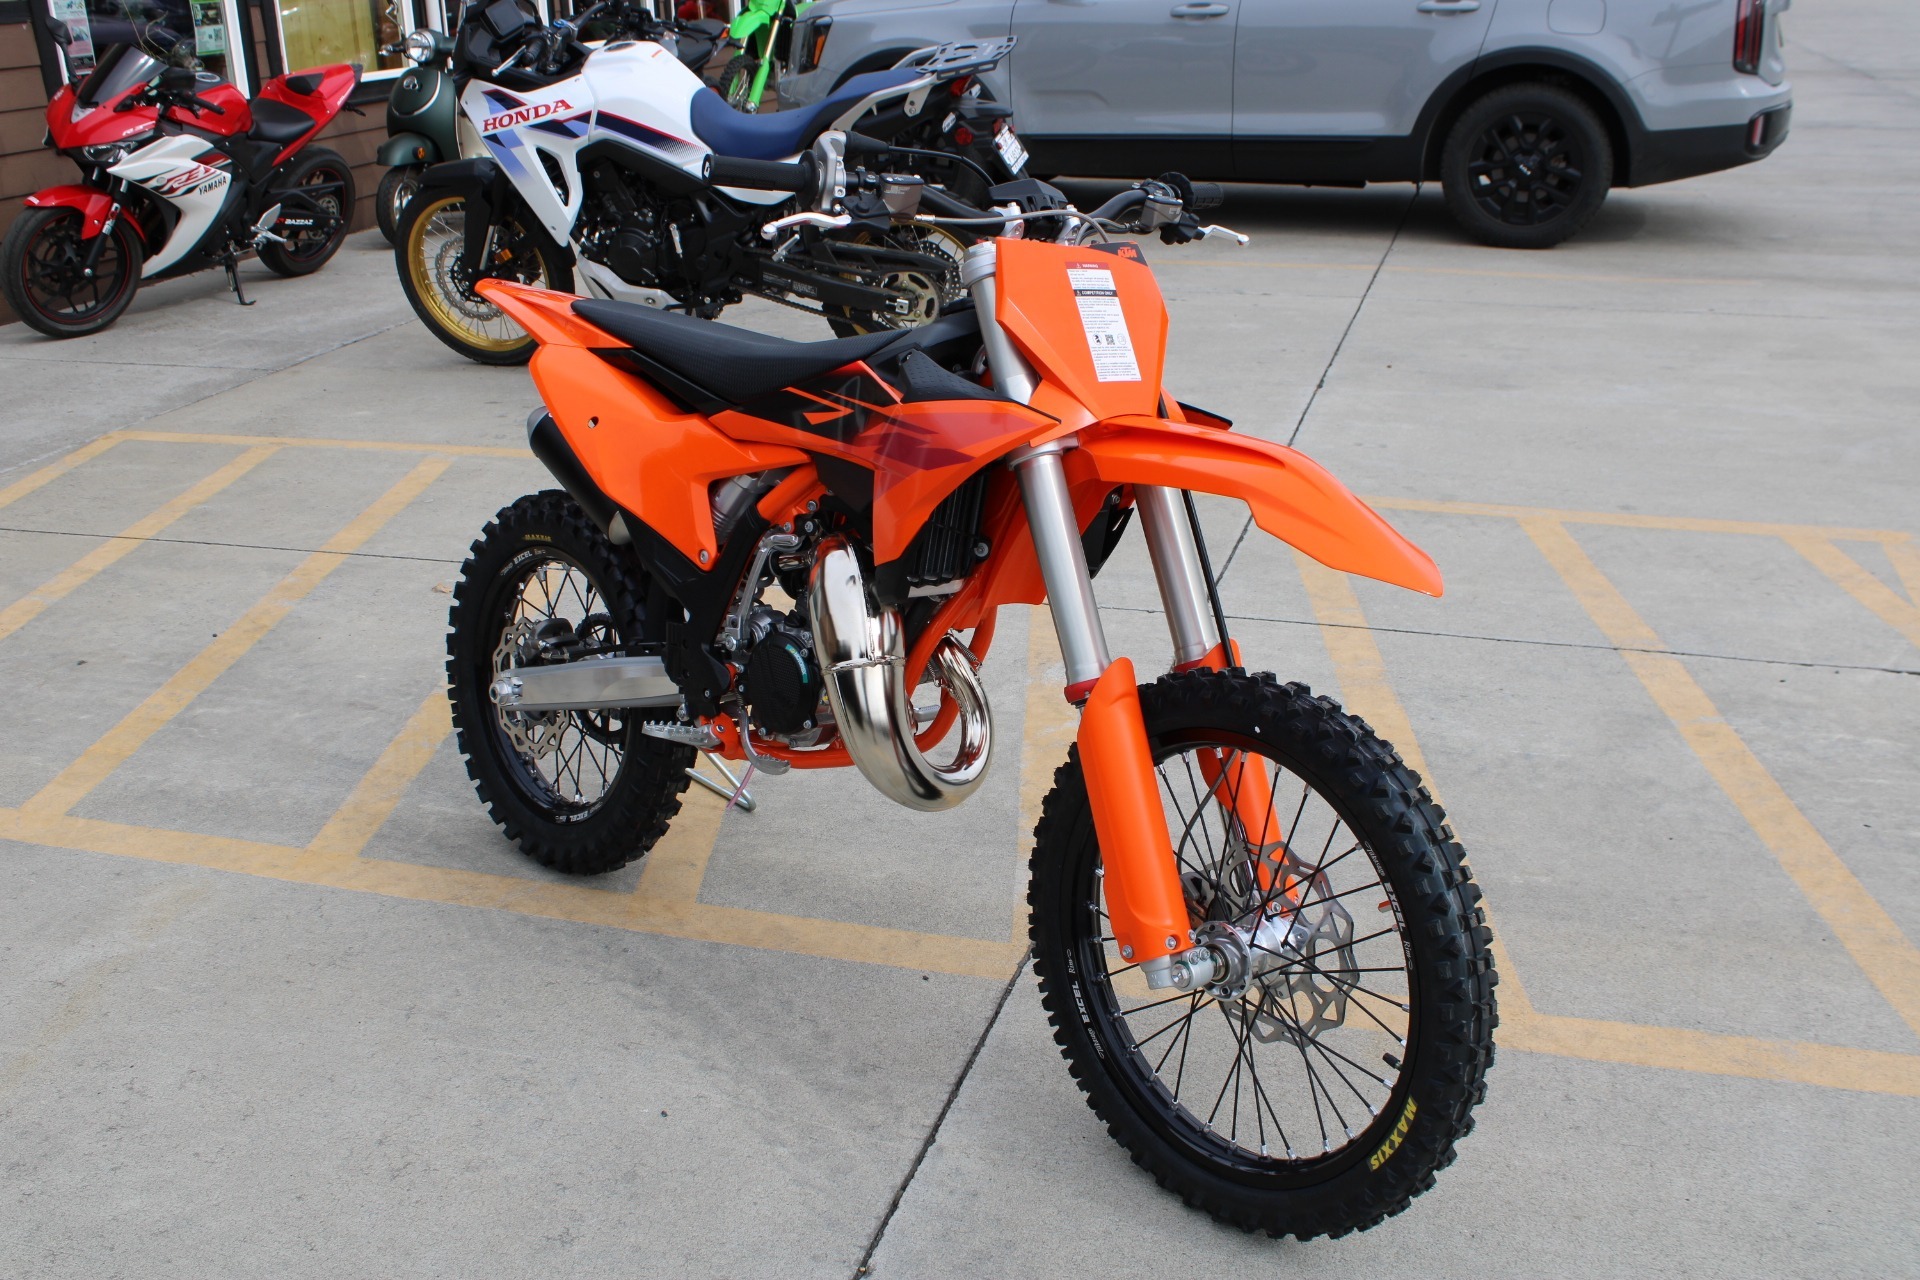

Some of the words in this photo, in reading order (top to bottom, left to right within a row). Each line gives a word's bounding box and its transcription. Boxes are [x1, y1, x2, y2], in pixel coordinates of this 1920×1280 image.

[483, 99, 574, 132] HONDA
[198, 176, 227, 195] YAMAHA
[1117, 247, 1138, 258] KTM
[513, 551, 533, 564] EXCEL
[1383, 881, 1407, 932] EXCEL
[1403, 940, 1412, 962] Rim
[1067, 954, 1076, 974] Rim
[1071, 980, 1091, 1024] EXCEL
[1370, 1096, 1418, 1170] MAXXIS
